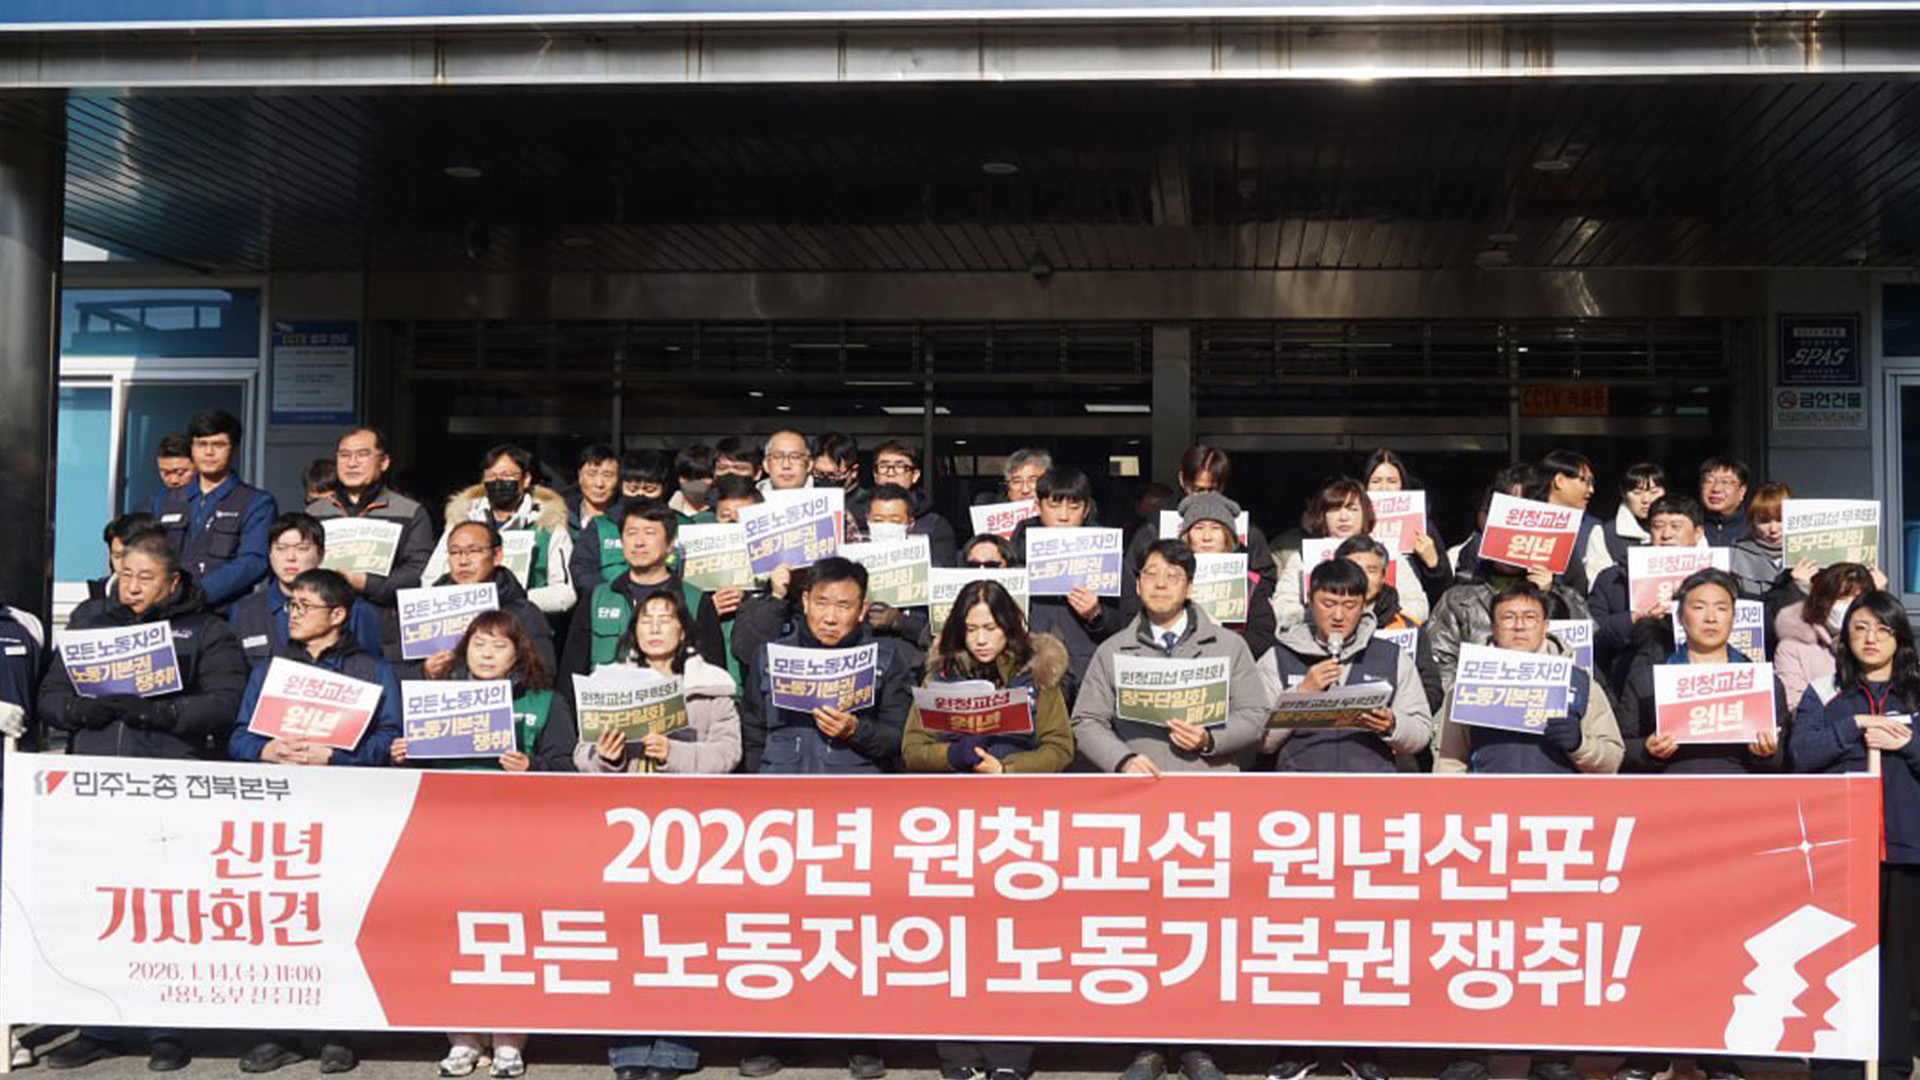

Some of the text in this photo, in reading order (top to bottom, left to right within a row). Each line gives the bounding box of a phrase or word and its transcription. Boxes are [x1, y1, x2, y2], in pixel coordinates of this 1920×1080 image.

[1787, 347, 1851, 367] SPAS
[771, 496, 829, 526] 노동자의
[1506, 508, 1571, 529] 원청교섭
[1786, 510, 1840, 532] 원청교섭
[1029, 532, 1119, 558] 모든 노동자의
[1506, 535, 1557, 561] 원년
[403, 586, 493, 620] 모든 노동자의
[66, 625, 166, 661] 모든 노동자의
[71, 654, 153, 683] 노동기본권
[774, 648, 873, 676] 모든 노동자의
[1120, 663, 1225, 686] 원청교섭 무력화
[1461, 660, 1569, 681] 모든 노동자의
[282, 674, 364, 705] 원청교섭
[580, 681, 679, 707] 원청교섭 무력화
[774, 675, 855, 698] 노동기본권
[1456, 685, 1549, 708] 노동기본권
[1676, 667, 1755, 697] 원청교섭
[407, 684, 507, 715] 모든 노동자의
[934, 691, 1011, 712] 원청교섭
[1121, 686, 1208, 709] 창구단일화
[279, 704, 342, 738] 원년
[407, 712, 491, 742] 노동기본권
[582, 702, 667, 732] 창구단일화
[949, 711, 1002, 732] 원년
[1687, 699, 1745, 736] 원년
[73, 770, 291, 802] 민주노총 전북본부
[211, 820, 323, 881] 신년
[603, 806, 1636, 901] 2026년 원청교섭 원년선포!
[96, 887, 324, 946] 기자회견
[450, 909, 1642, 1010] 모든 노동자의 노동기본권 쟁취!
